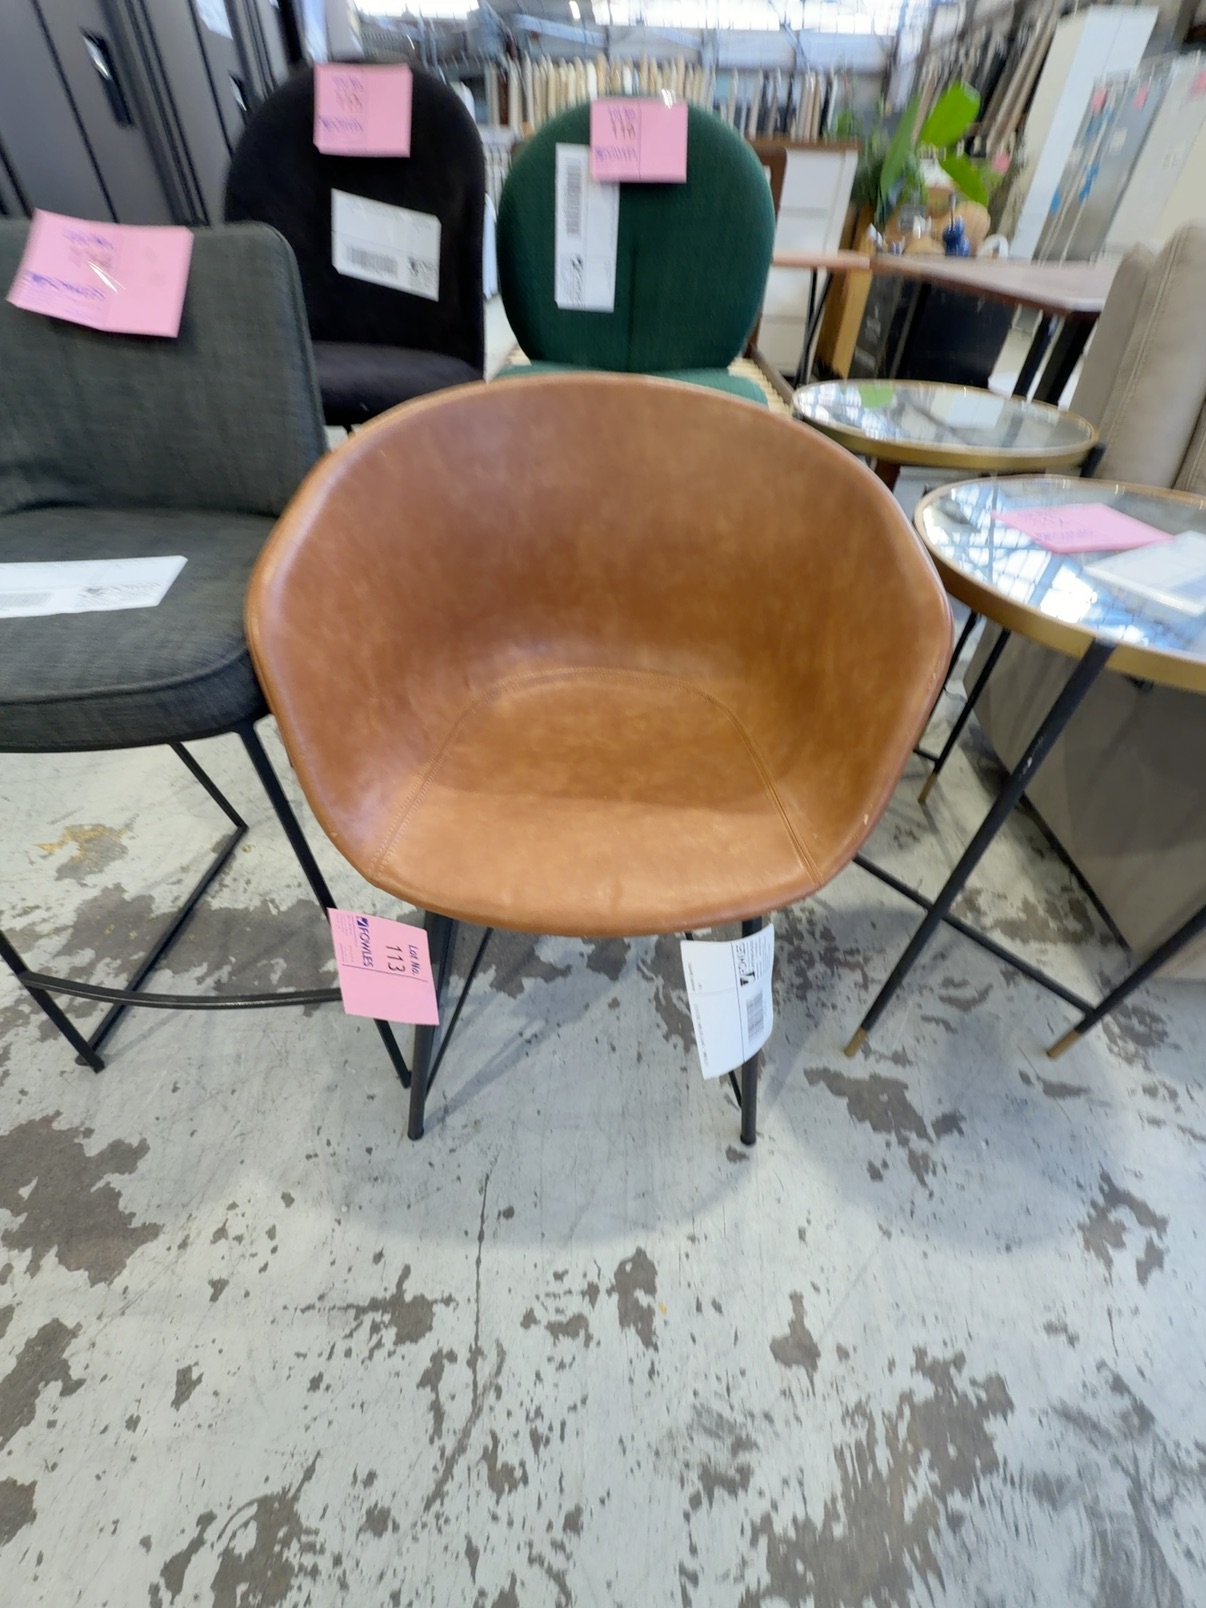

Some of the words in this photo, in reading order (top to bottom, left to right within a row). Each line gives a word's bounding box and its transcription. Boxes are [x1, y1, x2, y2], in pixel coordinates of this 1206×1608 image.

[358, 927, 374, 967] FOWLES
[385, 945, 406, 973] 113
[408, 944, 419, 960] Lot
